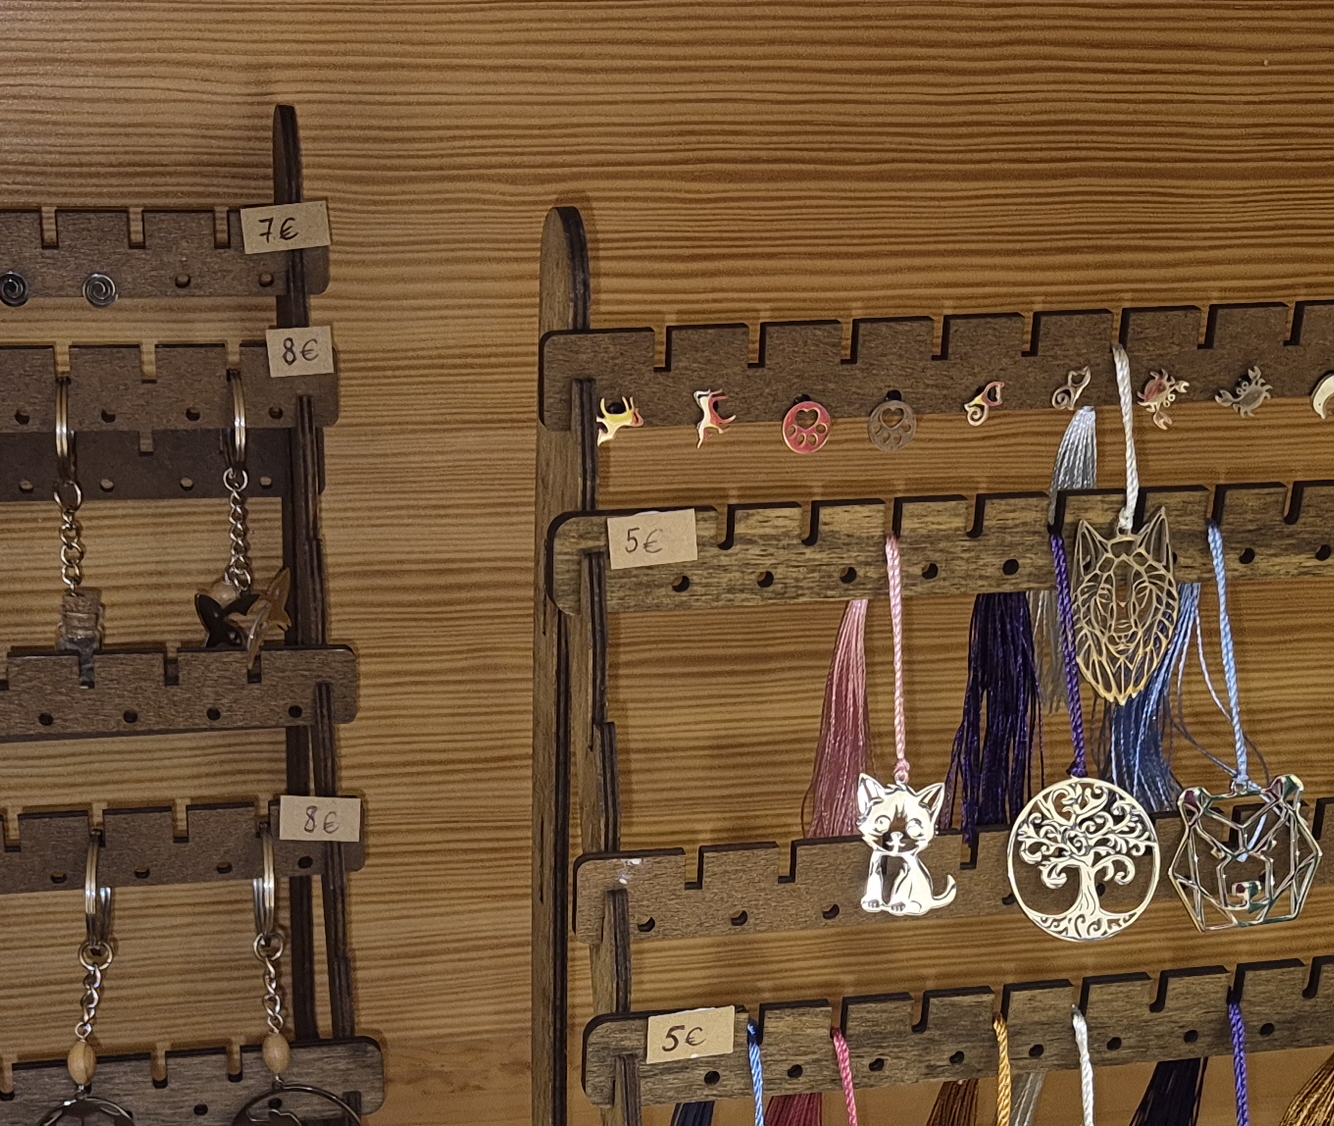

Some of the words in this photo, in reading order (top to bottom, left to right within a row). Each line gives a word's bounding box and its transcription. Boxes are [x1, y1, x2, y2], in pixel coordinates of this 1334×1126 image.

[257, 216, 300, 244] 7€
[282, 336, 320, 367] 8€
[624, 526, 664, 555] 5€
[303, 804, 340, 835] 8€
[661, 1024, 707, 1053] 5€
